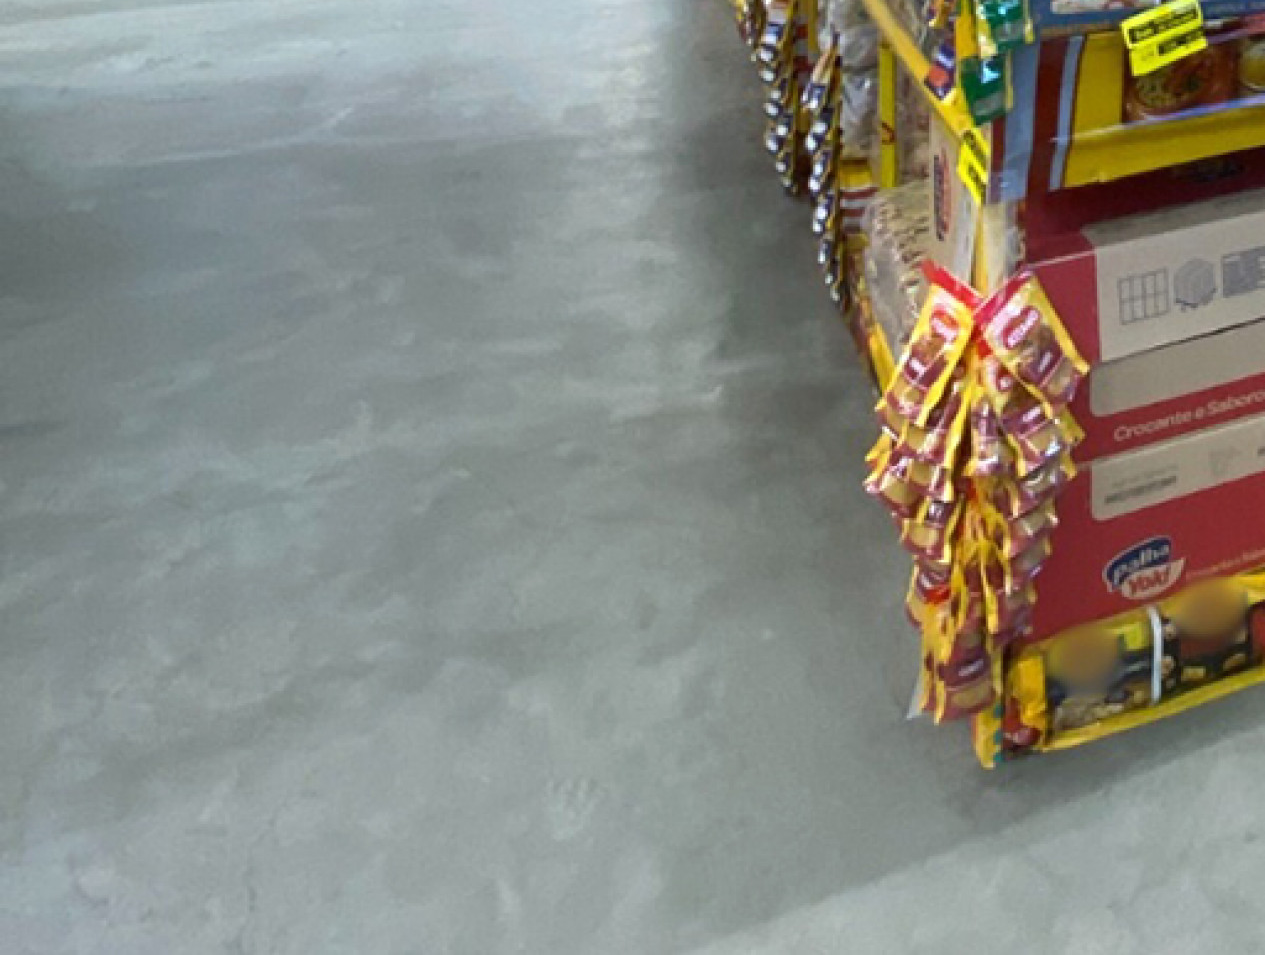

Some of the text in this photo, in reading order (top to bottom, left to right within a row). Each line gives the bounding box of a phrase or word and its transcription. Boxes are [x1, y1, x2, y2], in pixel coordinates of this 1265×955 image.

[1113, 410, 1192, 442] Crocante
[1195, 406, 1205, 419] e
[1112, 543, 1170, 587] palha
